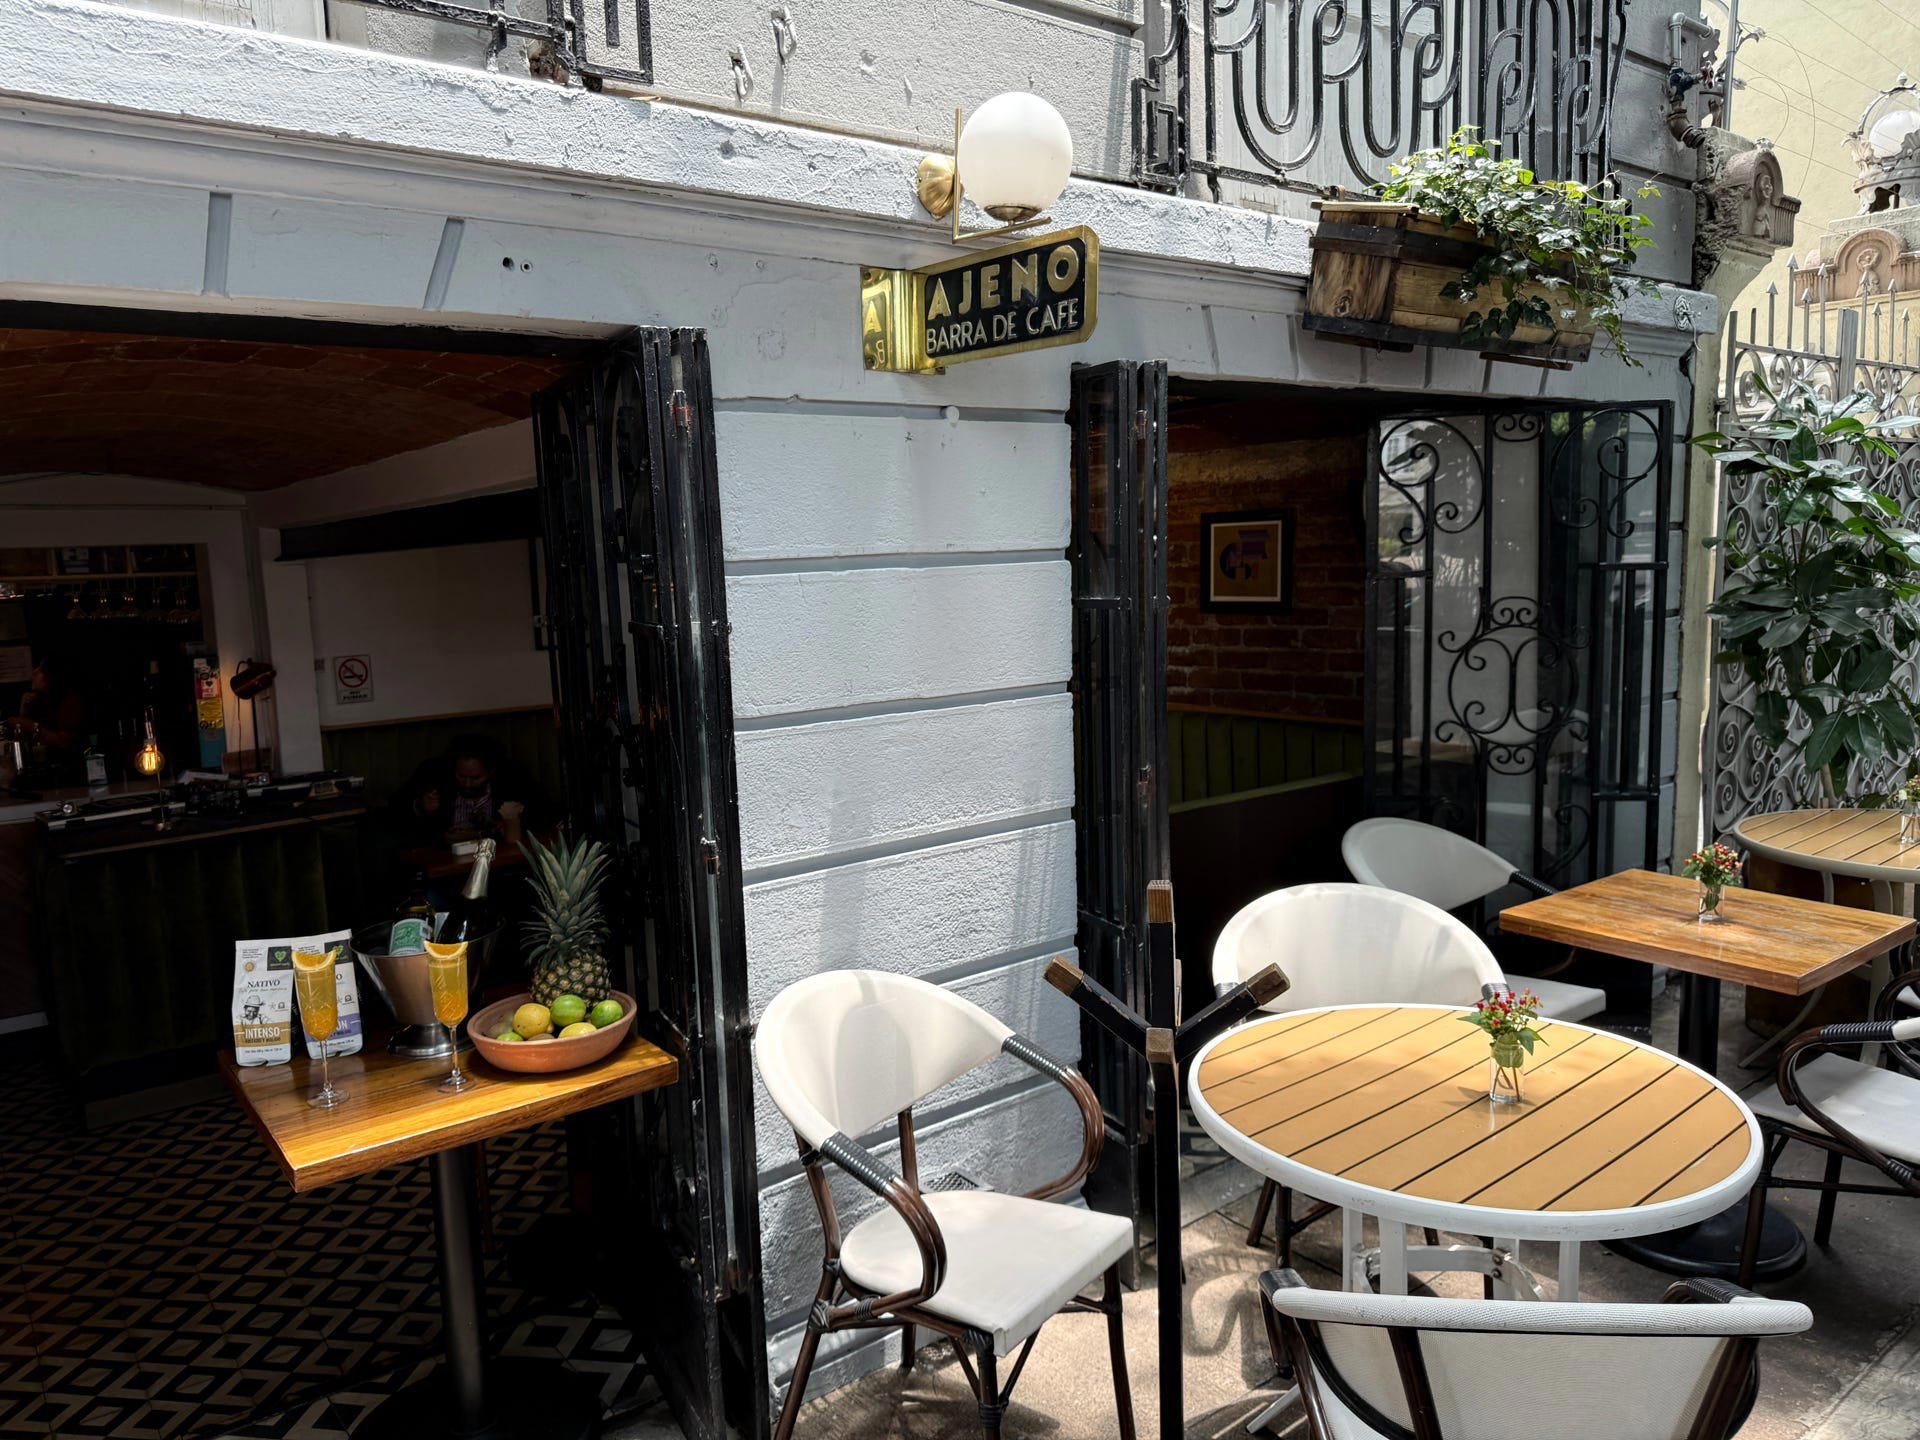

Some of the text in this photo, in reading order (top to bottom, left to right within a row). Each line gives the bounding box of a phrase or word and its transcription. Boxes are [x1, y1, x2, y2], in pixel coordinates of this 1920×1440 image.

[927, 244, 1080, 321] AJENO
[926, 318, 988, 353] BARRA
[992, 311, 1017, 342] DE
[247, 978, 281, 988] NATIVO
[245, 1026, 280, 1038] INTENSO
